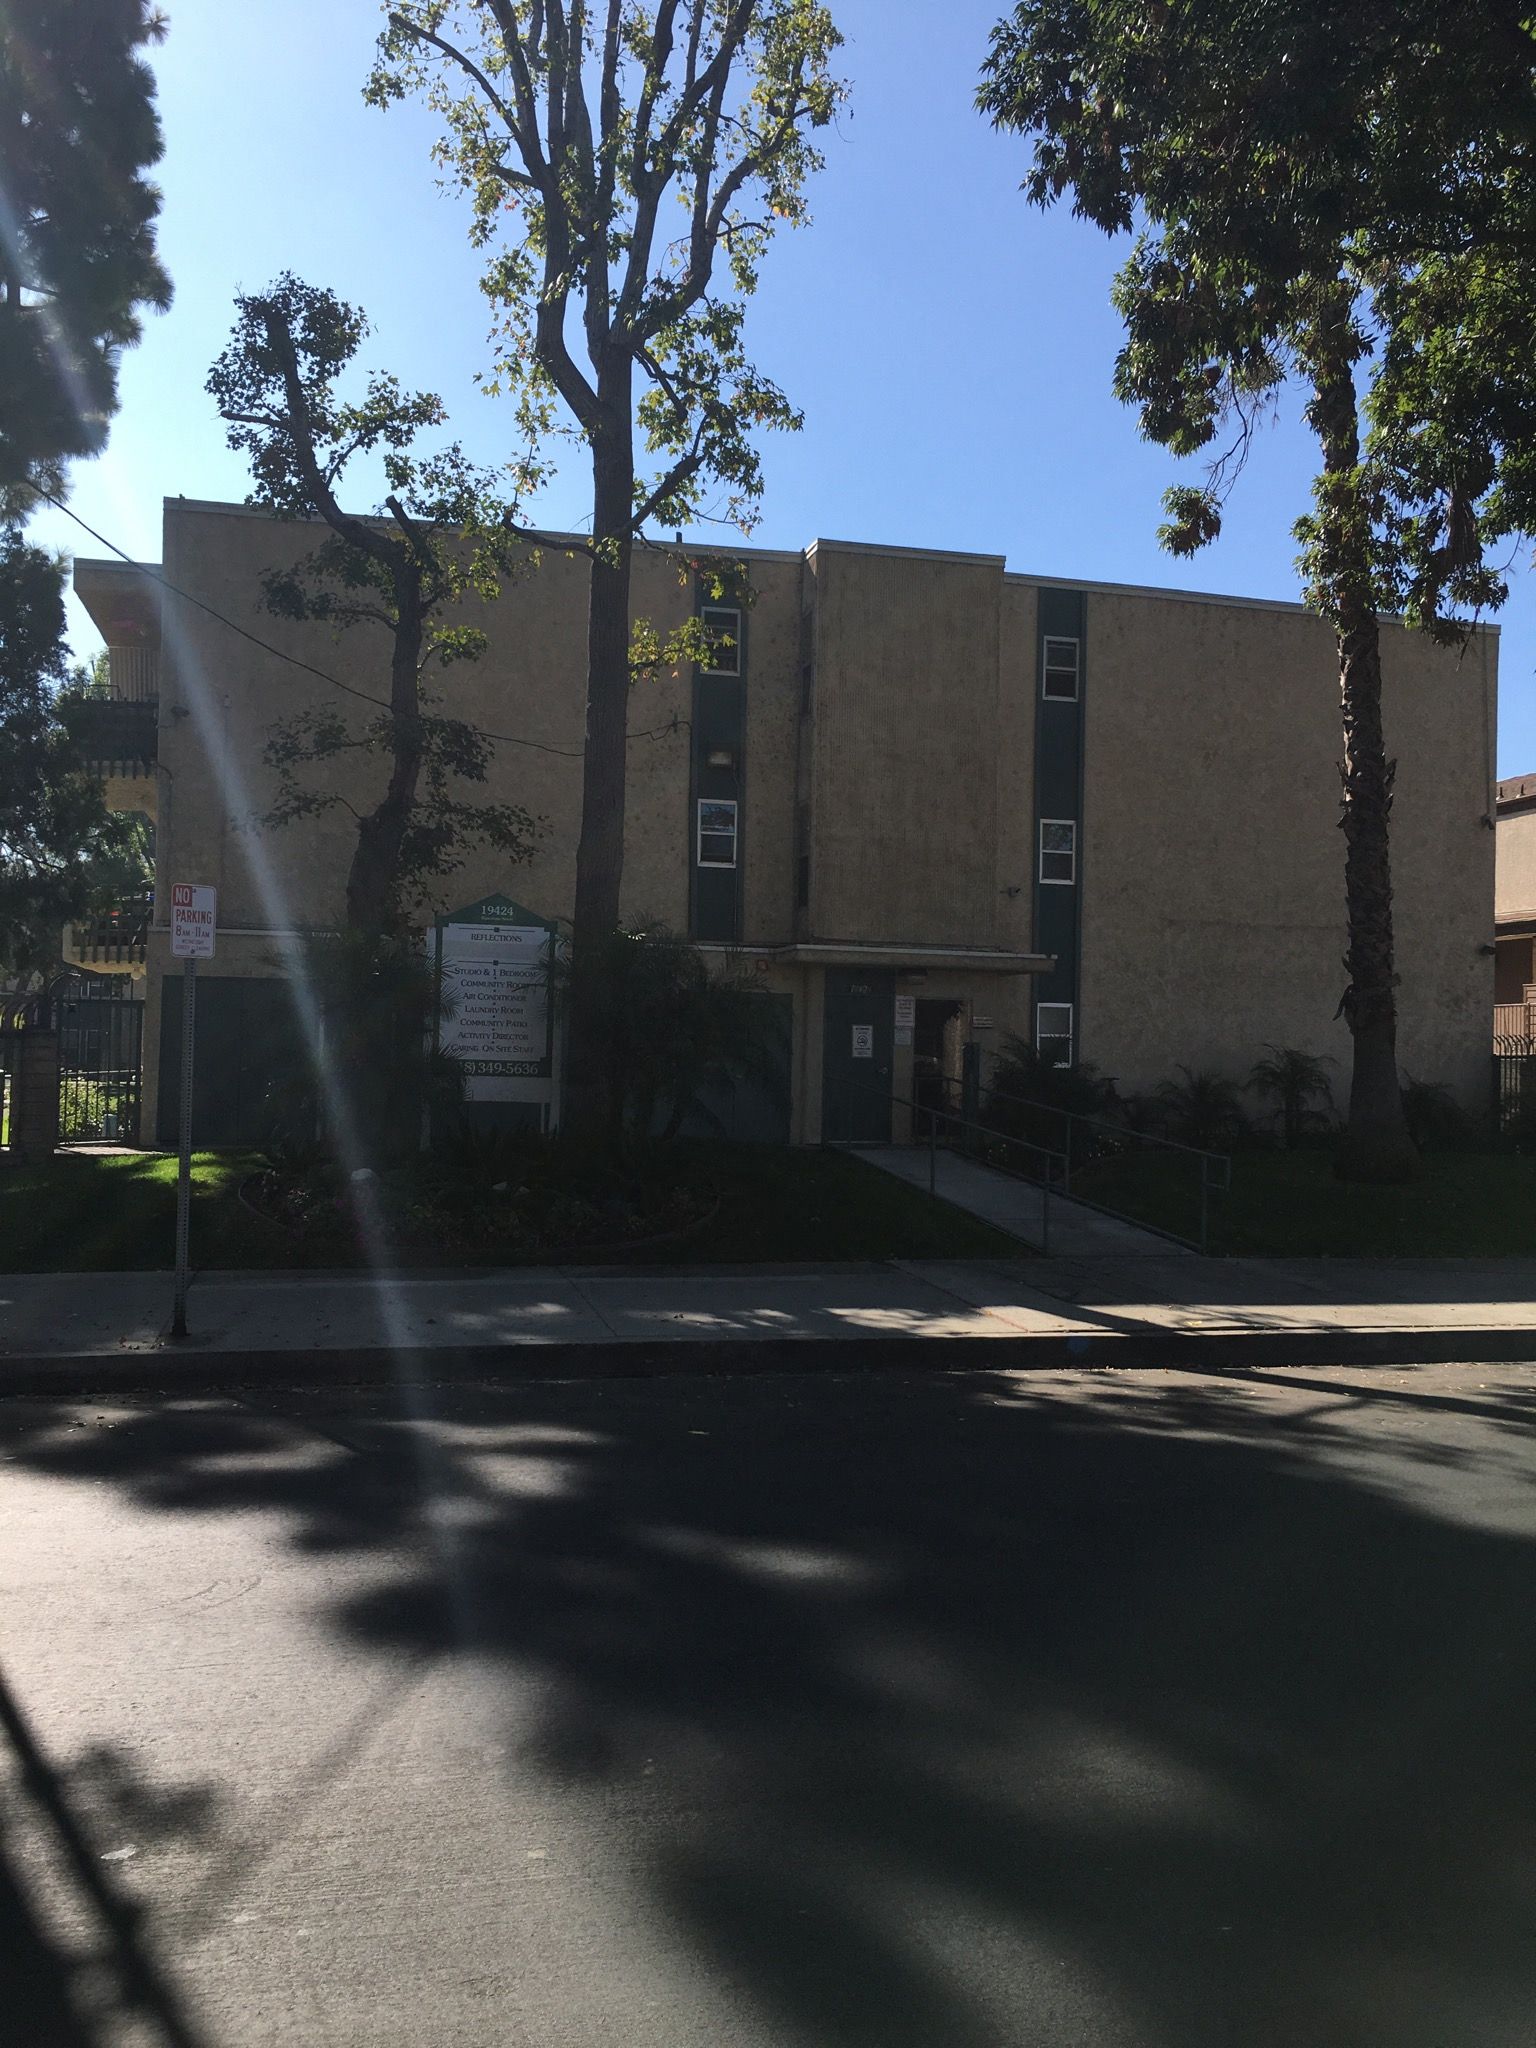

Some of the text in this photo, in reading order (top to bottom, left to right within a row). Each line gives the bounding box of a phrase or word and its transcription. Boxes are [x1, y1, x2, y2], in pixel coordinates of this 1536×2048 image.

[175, 887, 190, 904] NO
[481, 905, 514, 916] 19424
[175, 909, 212, 925] PARKING
[471, 933, 522, 943] REFLECTIONS
[454, 967, 537, 977] STUDIO & 1 BEDROOM
[460, 979, 505, 988] COMMUNITY
[463, 992, 527, 1001] AIR CONDITIONER
[464, 1005, 524, 1015] LAUNDRY ROOM
[460, 1018, 528, 1028] COMMUNITY PATIO
[458, 1031, 529, 1041] ACTIVITY DIRECTOR
[450, 1043, 535, 1054] CARING ON SITE STAFF
[477, 1062, 539, 1075] 349-5636
